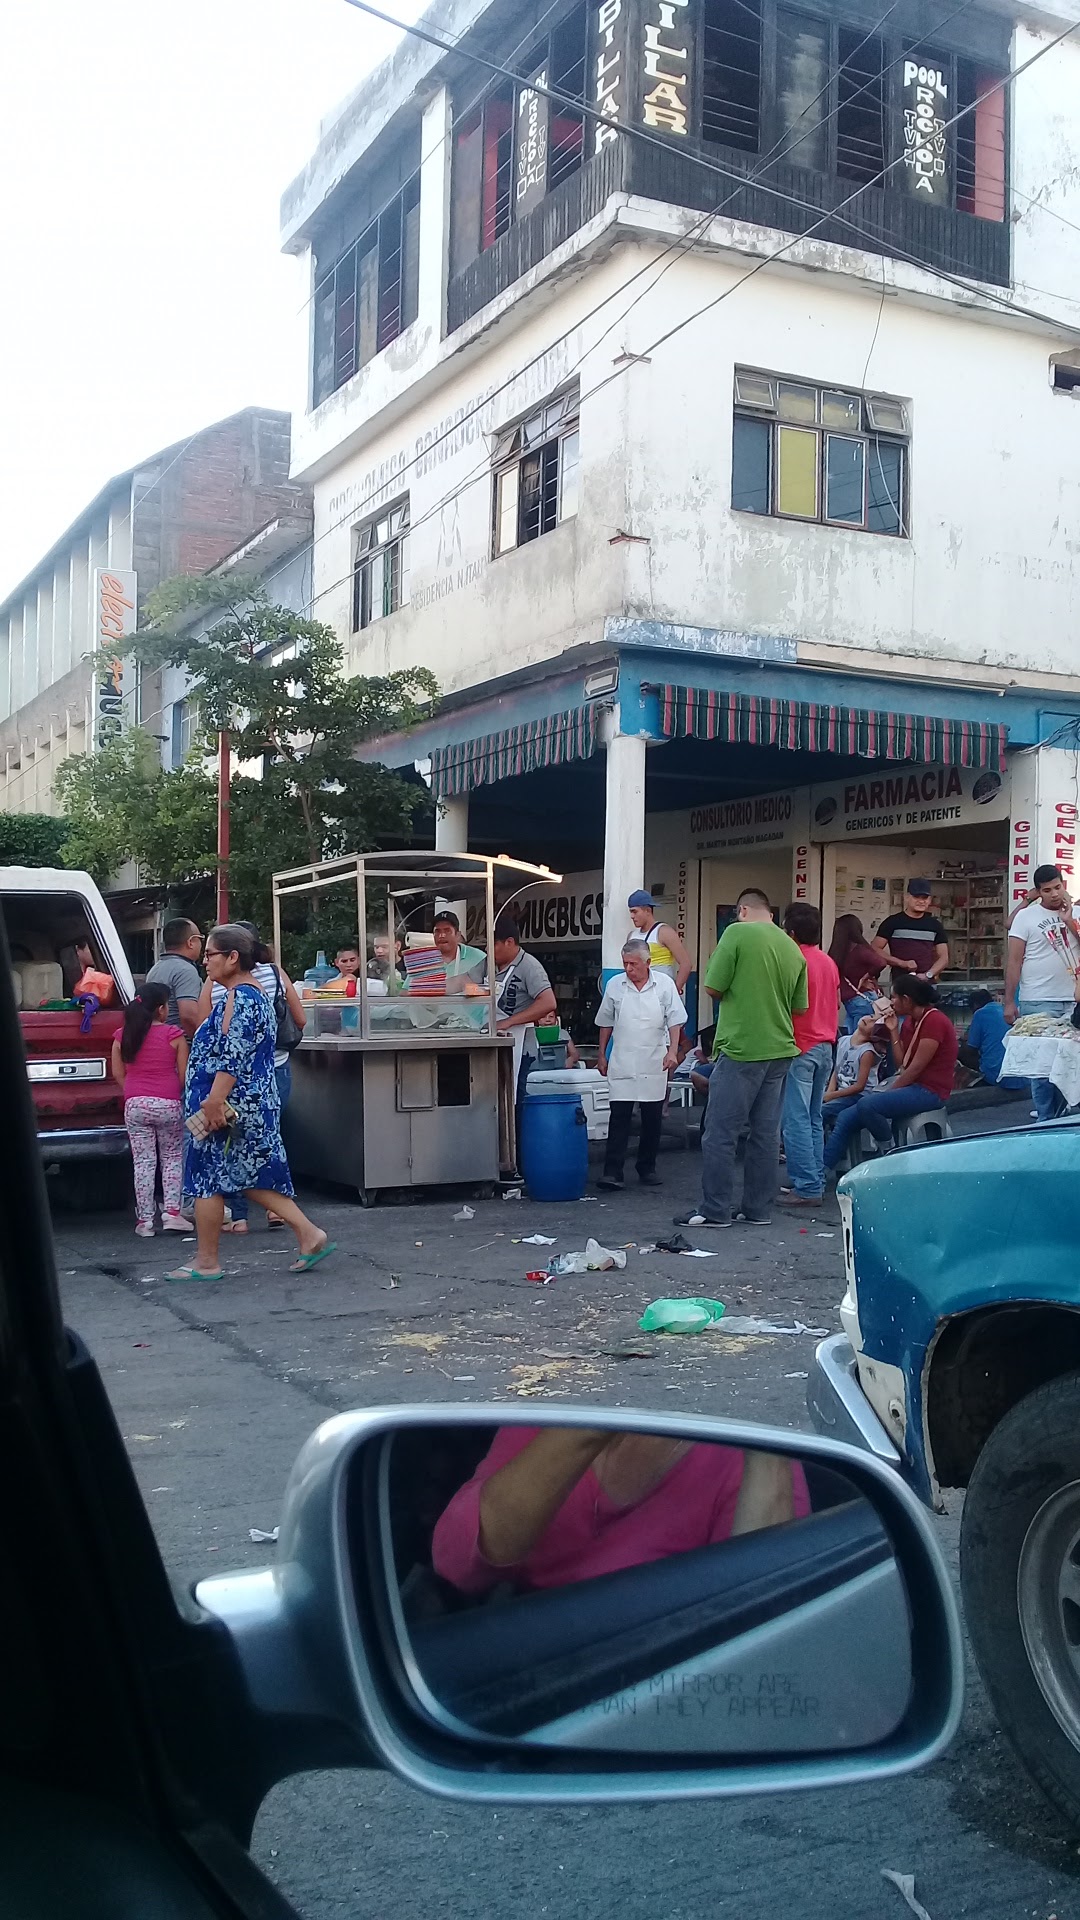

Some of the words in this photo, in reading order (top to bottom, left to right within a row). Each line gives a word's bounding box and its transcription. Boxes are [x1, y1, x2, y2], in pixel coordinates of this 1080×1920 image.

[595, 0, 622, 155] BILLAR
[643, 0, 688, 135] ILLAR
[904, 60, 948, 99] POOL
[527, 98, 539, 188] ROCKOLA
[916, 86, 934, 193] ROCKOLA
[690, 800, 753, 833] CONSULTORIO
[754, 794, 792, 824] MEDICO
[844, 767, 963, 814] FARMACIA
[845, 814, 894, 832] GENERICOS
[896, 813, 903, 825] Y
[905, 811, 918, 824] DE
[920, 805, 962, 823] PATENTE
[678, 862, 686, 943] CONSULTOR
[650, 1672, 744, 1695] MIRROR
[727, 1696, 820, 1718] APPEAR
